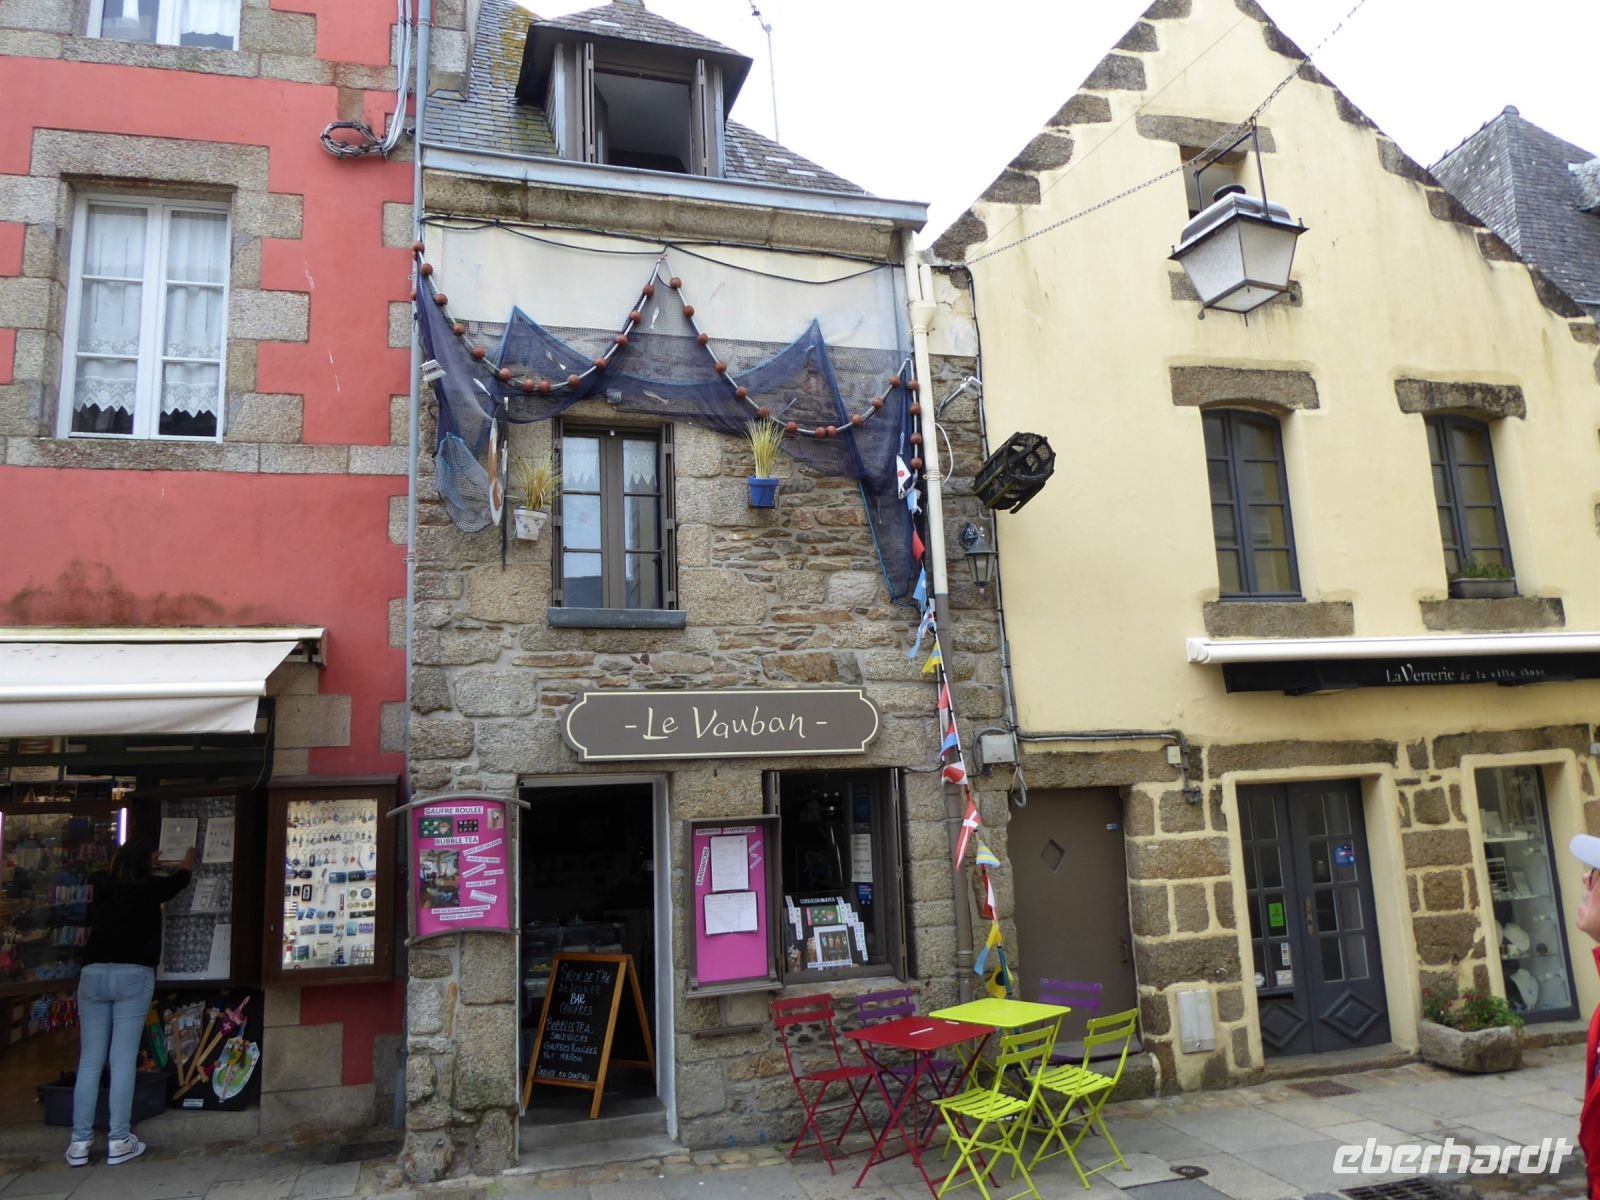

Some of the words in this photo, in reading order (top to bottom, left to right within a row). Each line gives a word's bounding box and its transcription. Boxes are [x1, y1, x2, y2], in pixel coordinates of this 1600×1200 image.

[1476, 670, 1487, 680] la
[642, 706, 679, 740] Le
[692, 706, 806, 739] Vauban
[465, 836, 478, 844] TEA
[570, 992, 586, 1005] BAR
